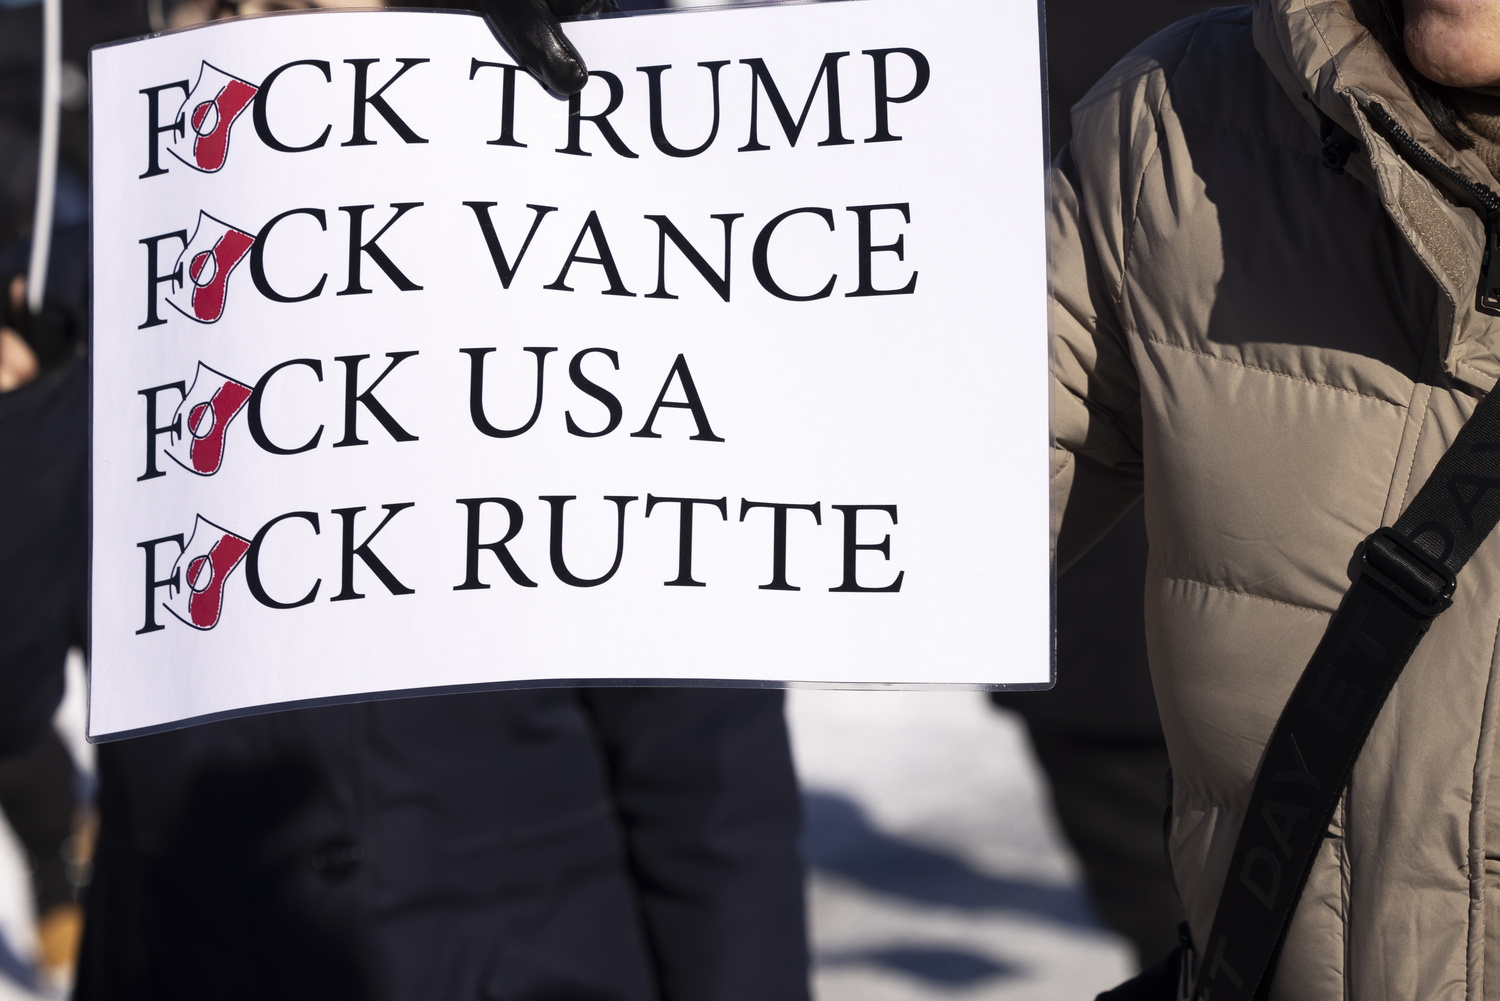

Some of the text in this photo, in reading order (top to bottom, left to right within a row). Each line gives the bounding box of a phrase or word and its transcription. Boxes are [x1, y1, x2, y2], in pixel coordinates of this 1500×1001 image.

[139, 48, 930, 179] FCK TRUMP
[138, 202, 918, 329] FCK VANCE
[137, 347, 725, 481] FCK USA
[136, 493, 904, 635] FCK RUTTE
[1239, 732, 1322, 911] DAY
